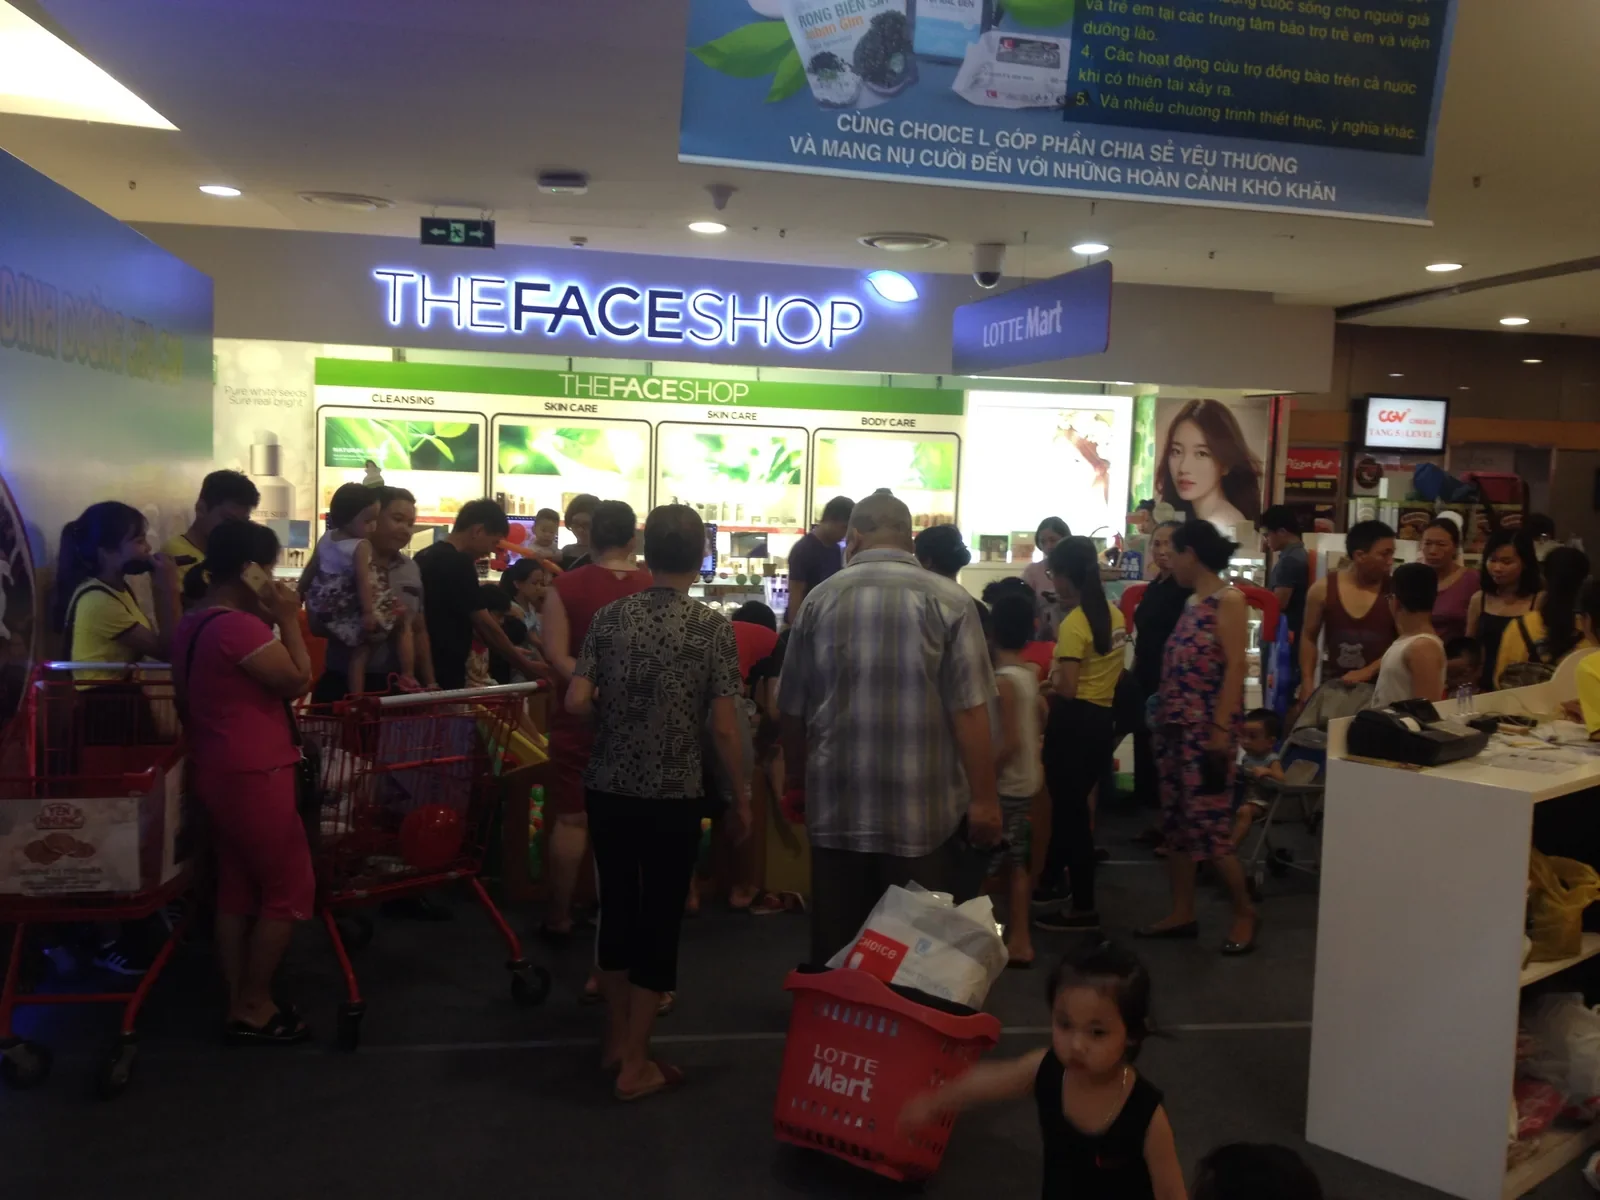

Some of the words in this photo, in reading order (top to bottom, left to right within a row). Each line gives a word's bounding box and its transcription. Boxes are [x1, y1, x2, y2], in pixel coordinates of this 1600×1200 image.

[798, 7, 833, 28] RONG
[1132, 4, 1154, 17] em
[1159, 6, 1175, 22] tại
[1179, 10, 1203, 24] các
[1209, 12, 1245, 31] trung
[1250, 16, 1275, 32] tâm
[1280, 20, 1305, 35] bảo
[1309, 24, 1327, 40] trợ
[1331, 26, 1349, 41] trẻ
[1353, 32, 1374, 44] em
[1379, 33, 1395, 47] và
[1400, 35, 1430, 51] viện
[1298, 1, 1330, 19] sống
[1335, 5, 1360, 19] cho
[1364, 10, 1404, 25] người
[1408, 13, 1430, 29] già
[1083, 20, 1130, 41] dưỡng
[1078, 68, 1100, 83] khi
[1105, 71, 1122, 86] có
[1127, 73, 1163, 90] thiên
[1167, 77, 1184, 92] tai
[1188, 80, 1212, 98] xảy
[1080, 44, 1095, 60] 4.
[1104, 46, 1134, 63] Các
[1138, 50, 1170, 68] hoạt
[1174, 54, 1209, 74] động
[1214, 59, 1239, 74] cứu
[1244, 63, 1262, 80] trợ
[1265, 64, 1300, 84] đồng
[1304, 68, 1330, 84] bào
[1334, 73, 1359, 88] trên
[1363, 75, 1380, 91] cả
[1384, 79, 1417, 95] nước
[1075, 92, 1089, 107] 5.
[1100, 93, 1119, 109] Và
[1124, 96, 1163, 113] nhiều
[1168, 102, 1220, 123] chương
[1225, 106, 1256, 121] trình
[1260, 110, 1290, 125] thiết
[1331, 116, 1340, 135] ý
[1343, 120, 1379, 137] nghĩa
[837, 111, 895, 138] CÙNG
[900, 120, 974, 149] CHOICE
[979, 129, 991, 147] L
[995, 127, 1037, 151] GÓP
[1042, 130, 1096, 157] PHẦN
[1100, 139, 1145, 161] CHIA
[1149, 138, 1175, 164] SẺ
[1179, 144, 1216, 172] YÊU
[1220, 150, 1298, 175] THƯƠNG
[789, 132, 817, 156] VÀ
[822, 139, 882, 165] MANG
[887, 149, 915, 169] NỤ
[919, 145, 967, 170] CƯỜI
[971, 147, 1012, 174] ĐẾN
[1016, 154, 1048, 177] VỚI
[1053, 158, 1121, 184] NHỮNG
[1126, 165, 1180, 191] HOÀN
[1184, 168, 1236, 198] CẢNH
[1241, 173, 1282, 202] KHÓ
[1286, 181, 1337, 206] KHĂN
[983, 316, 1025, 348] LOTTE
[1025, 300, 1063, 340] Mart
[251, 387, 277, 399] white
[279, 388, 308, 400] seeds
[372, 394, 435, 406] CLEANSING
[545, 401, 569, 412] SKIN
[570, 403, 598, 413] CARE
[708, 410, 729, 419] SKIN
[731, 411, 757, 420] CARE
[861, 417, 888, 427] BODY
[889, 418, 916, 428] CARE
[1378, 410, 1407, 423] CGV
[813, 1043, 880, 1076] LOTTE
[807, 1061, 874, 1103] Mart
